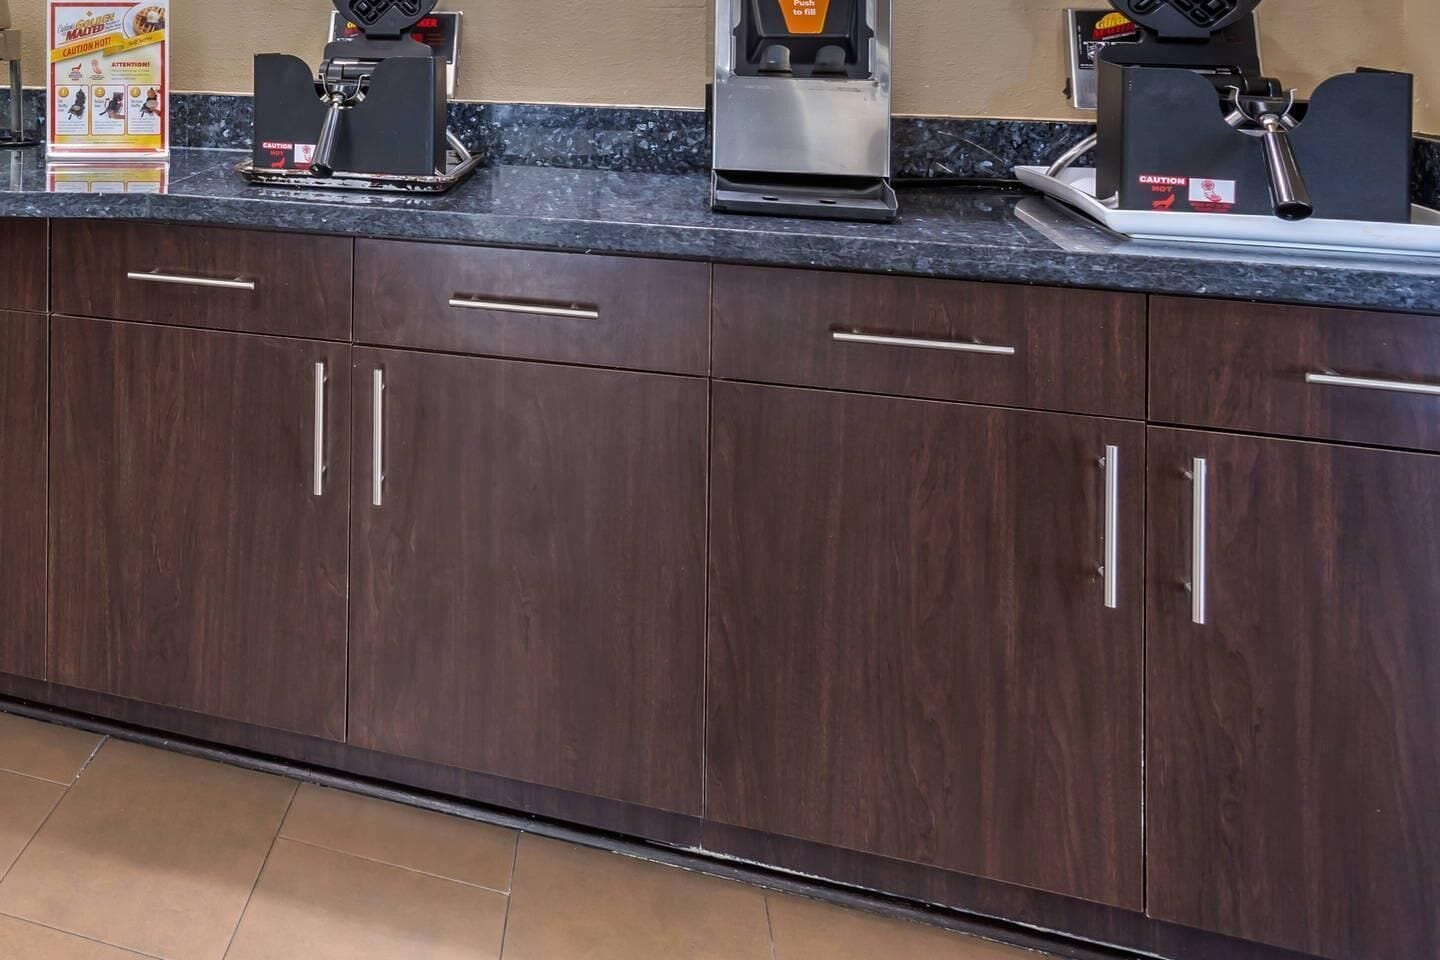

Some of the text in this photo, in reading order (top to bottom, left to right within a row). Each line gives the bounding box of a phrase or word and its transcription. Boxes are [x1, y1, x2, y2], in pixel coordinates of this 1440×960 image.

[793, 8, 817, 16] to fill
[65, 23, 105, 41] MALTED
[62, 41, 94, 57] CAUTION
[1139, 175, 1185, 185] CAUTION
